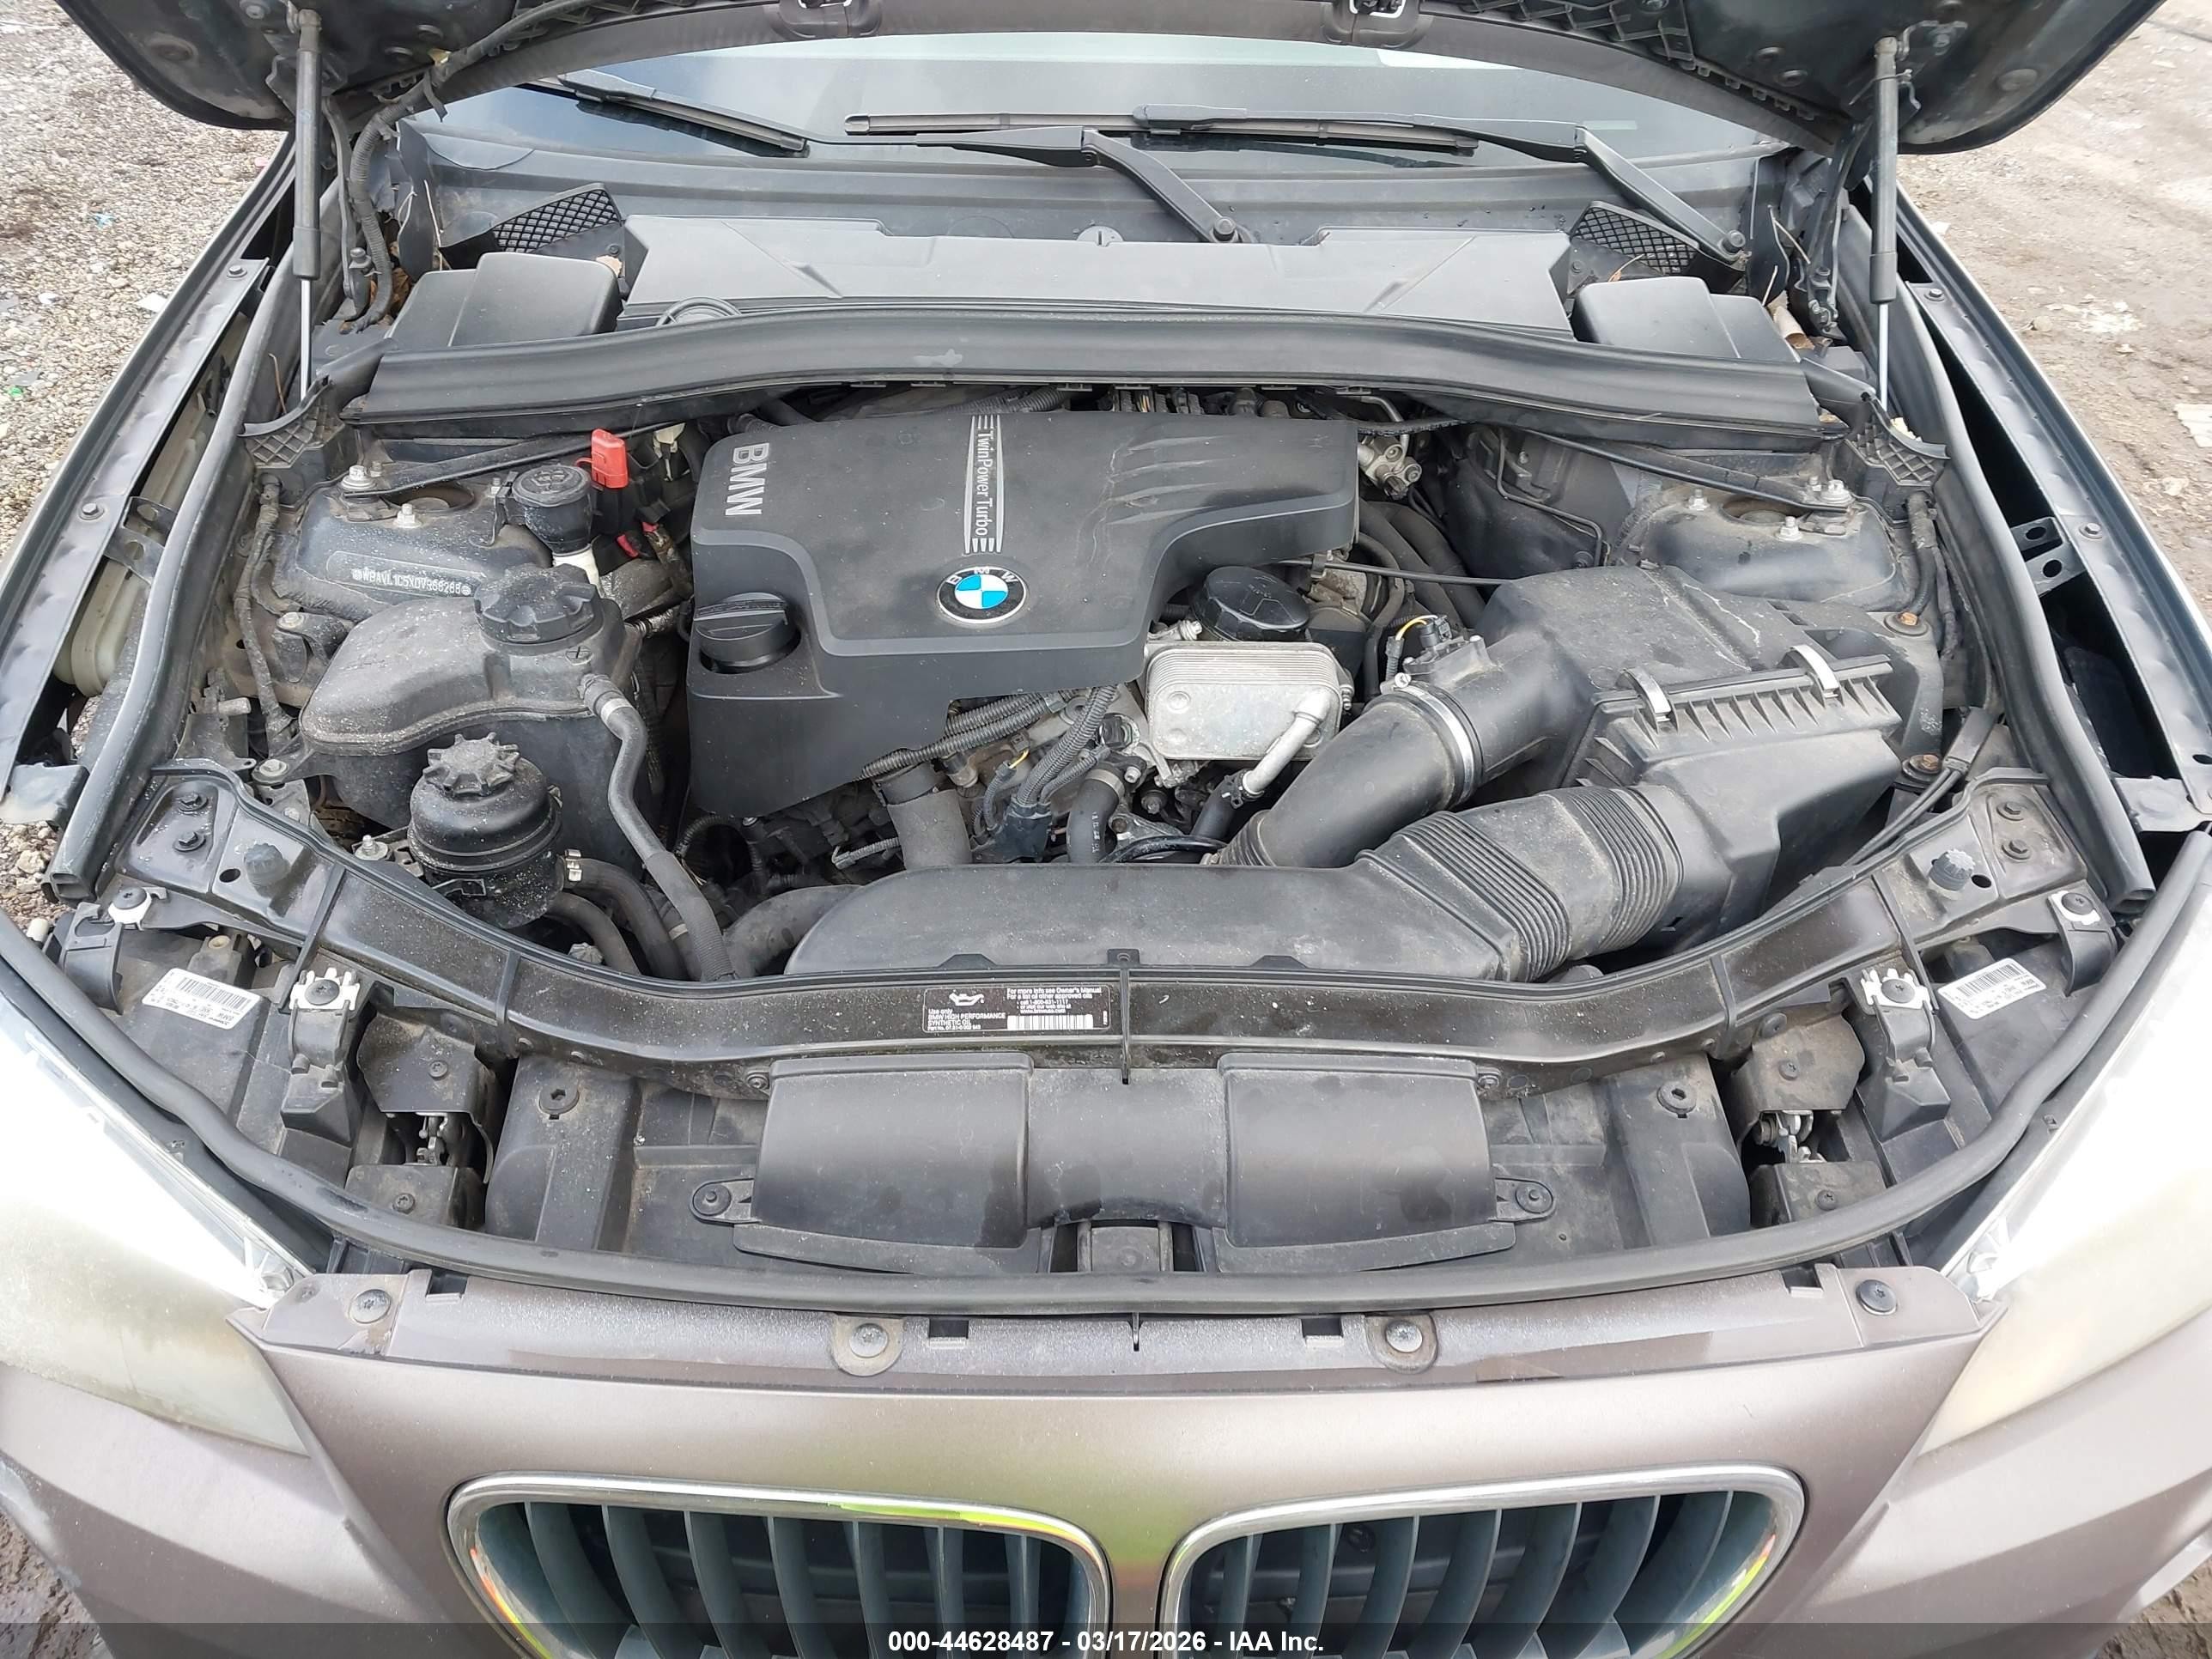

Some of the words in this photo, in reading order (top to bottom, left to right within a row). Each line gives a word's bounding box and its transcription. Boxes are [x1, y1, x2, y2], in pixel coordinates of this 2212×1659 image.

[726, 442, 769, 516] BMW
[975, 430, 994, 496] TwinPower
[975, 497, 994, 536] Turbo
[945, 567, 1019, 586] BMW
